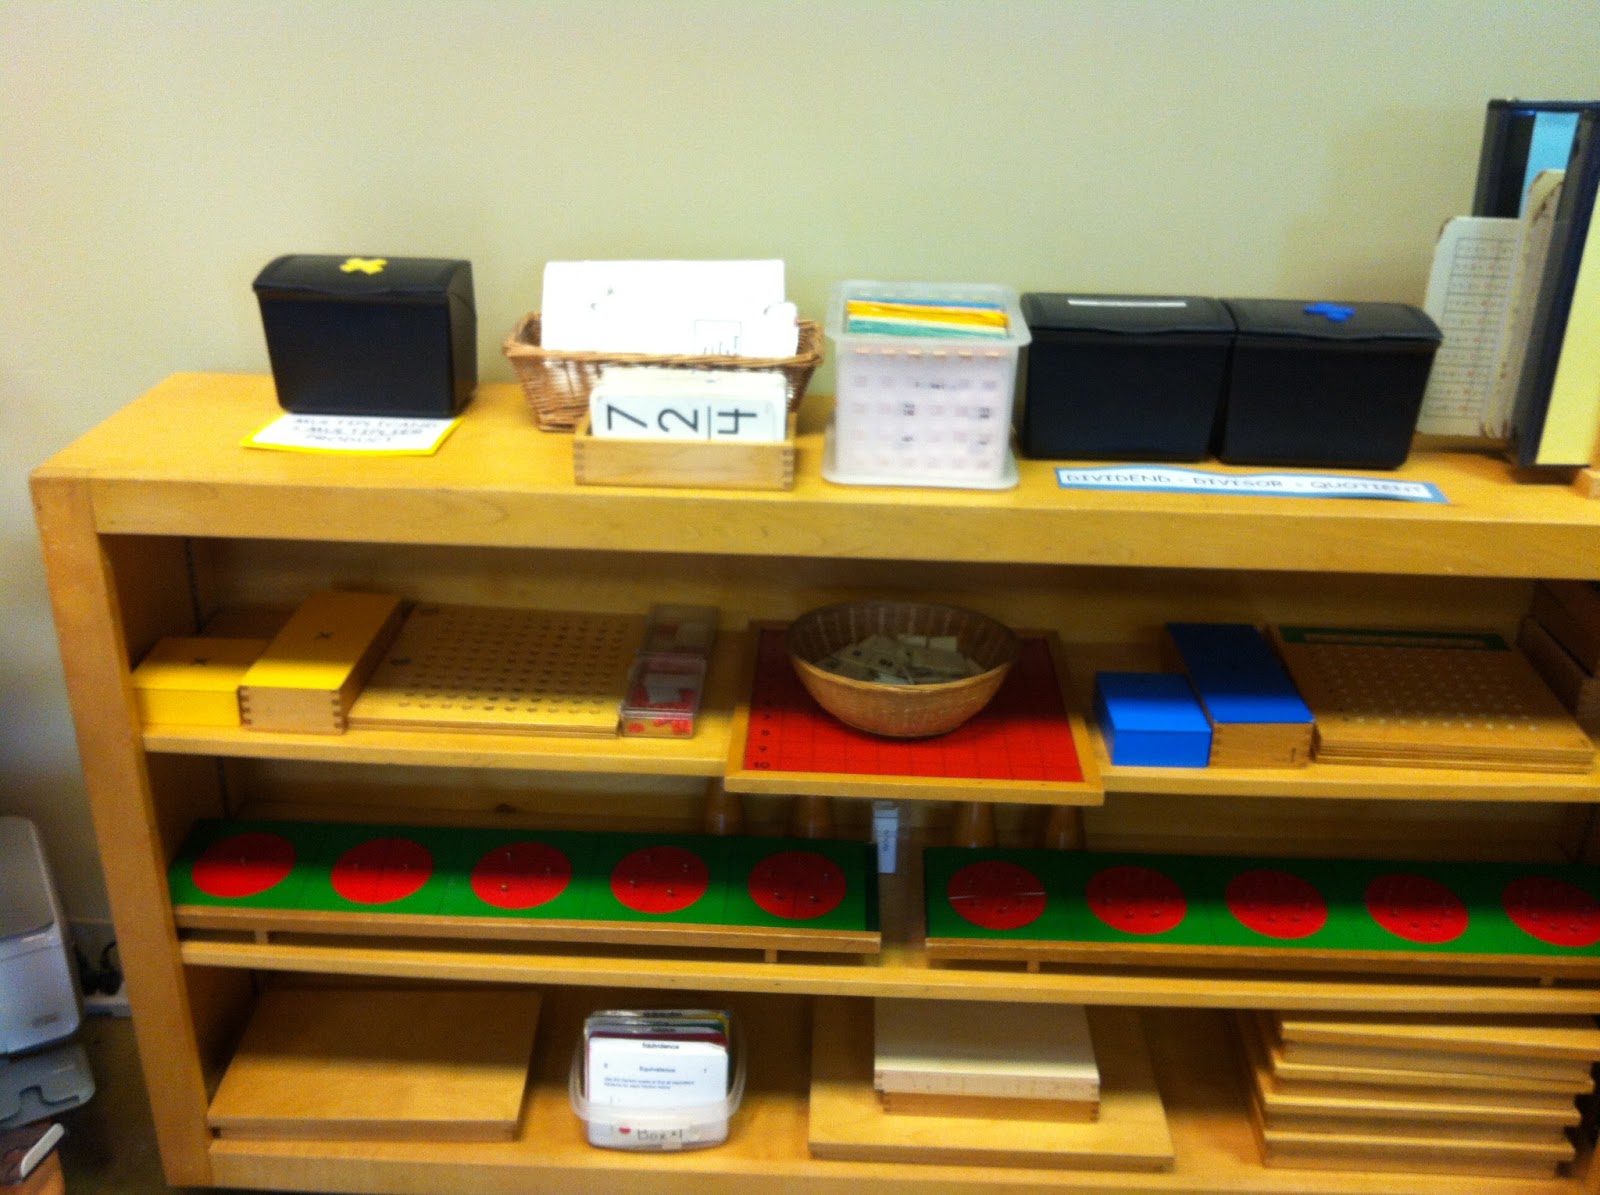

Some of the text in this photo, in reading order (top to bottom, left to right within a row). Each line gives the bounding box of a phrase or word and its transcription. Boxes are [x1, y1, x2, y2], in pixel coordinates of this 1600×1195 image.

[657, 408, 698, 432] 2
[717, 408, 757, 434] 4
[1066, 473, 1171, 483] DIVIDEND
[1193, 477, 1283, 488] DIVISOR
